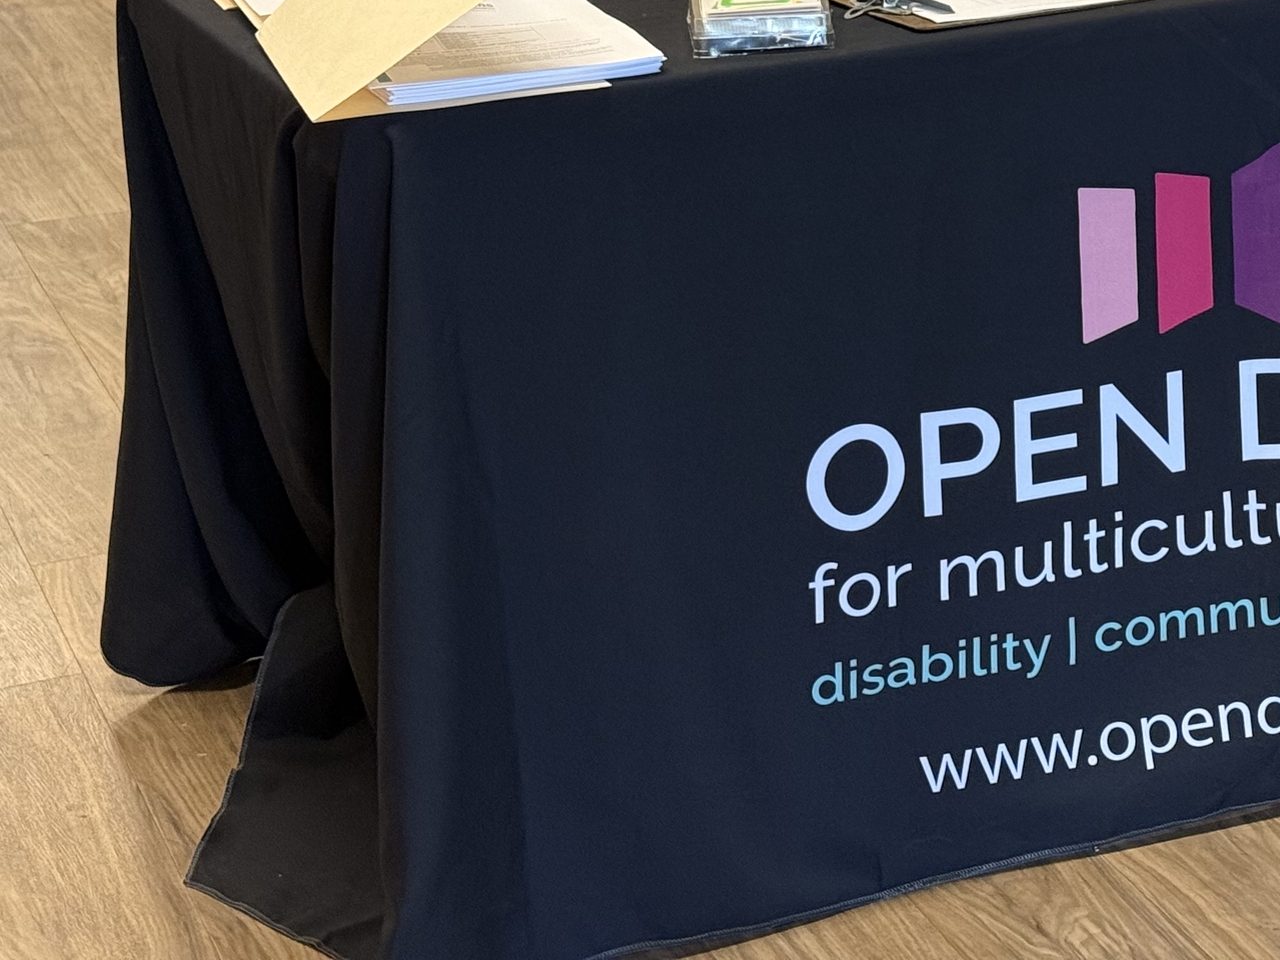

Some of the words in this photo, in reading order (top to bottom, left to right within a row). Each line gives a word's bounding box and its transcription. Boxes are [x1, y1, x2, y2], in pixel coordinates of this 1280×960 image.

[805, 369, 1186, 532] OPEN
[808, 561, 913, 624] for
[811, 632, 1052, 706] disability
